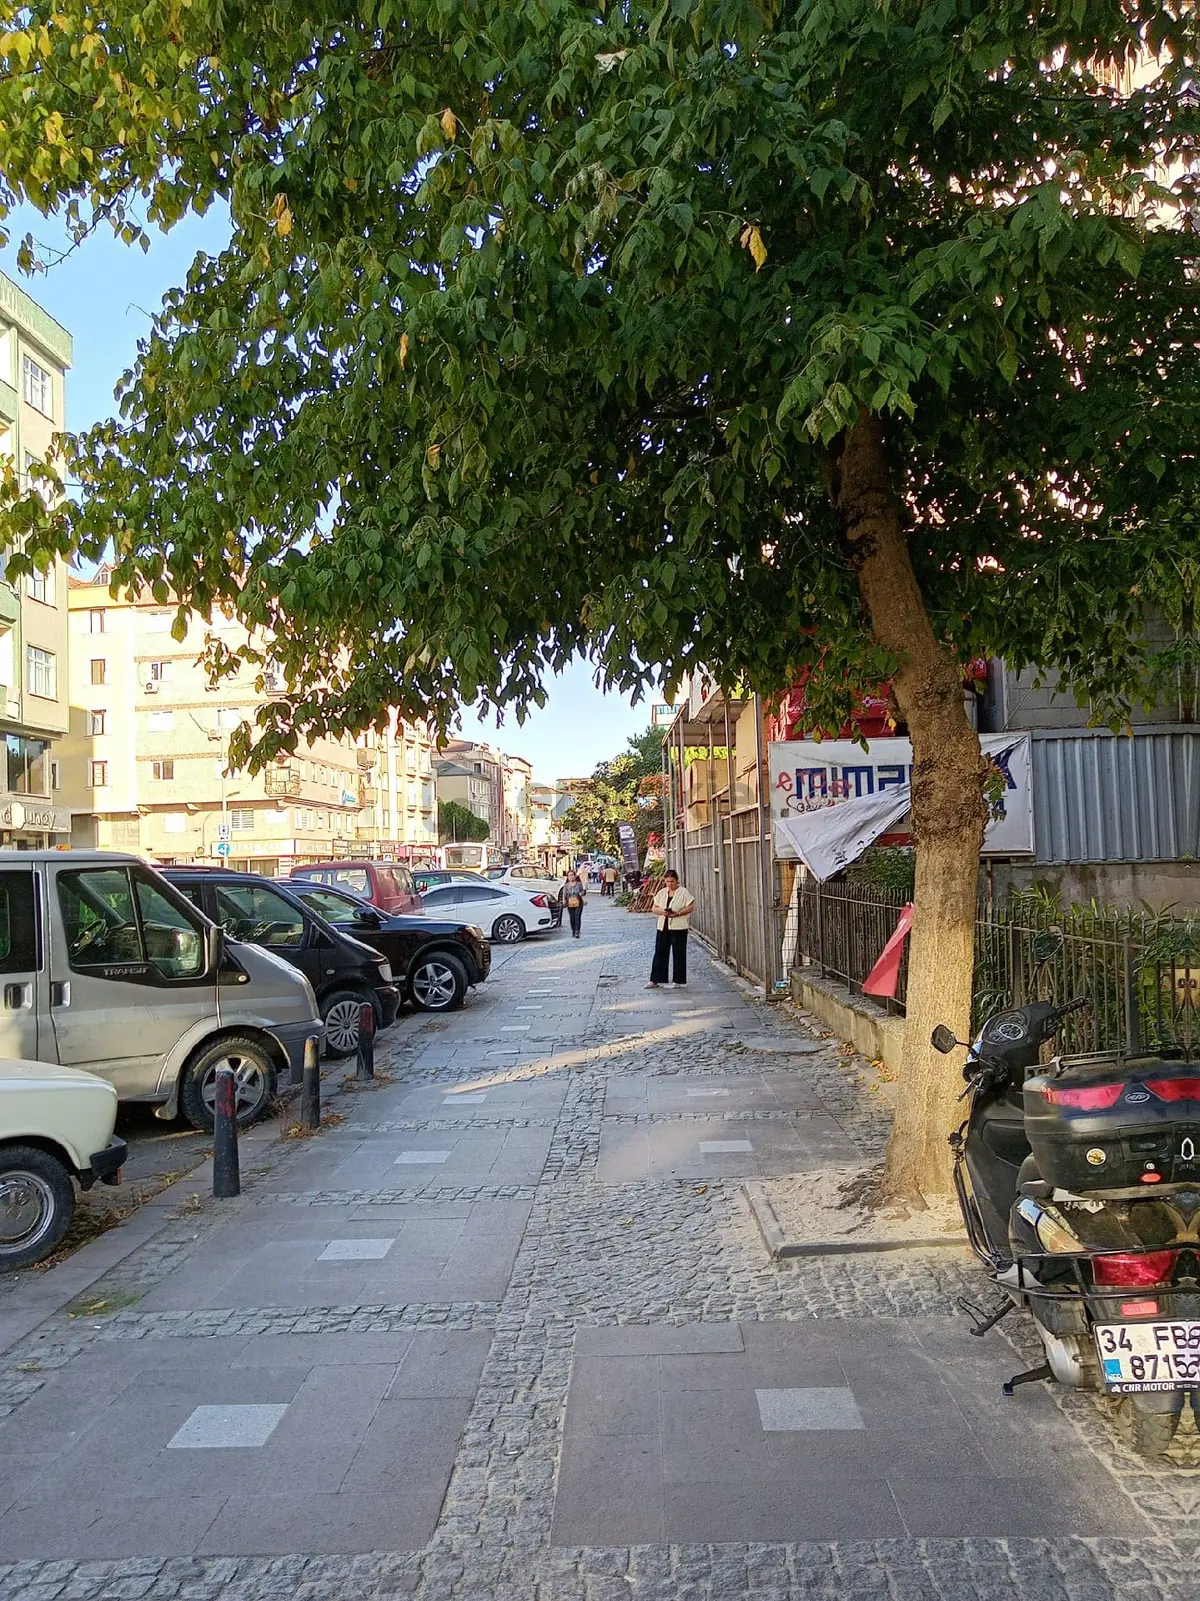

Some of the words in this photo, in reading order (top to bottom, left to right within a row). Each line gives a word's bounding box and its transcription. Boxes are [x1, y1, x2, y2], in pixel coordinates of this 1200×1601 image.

[103, 966, 149, 976] TRANSIT
[1101, 1327, 1133, 1353] 34
[1122, 1383, 1141, 1392] CNR
[1142, 1382, 1175, 1392] MOTOR
